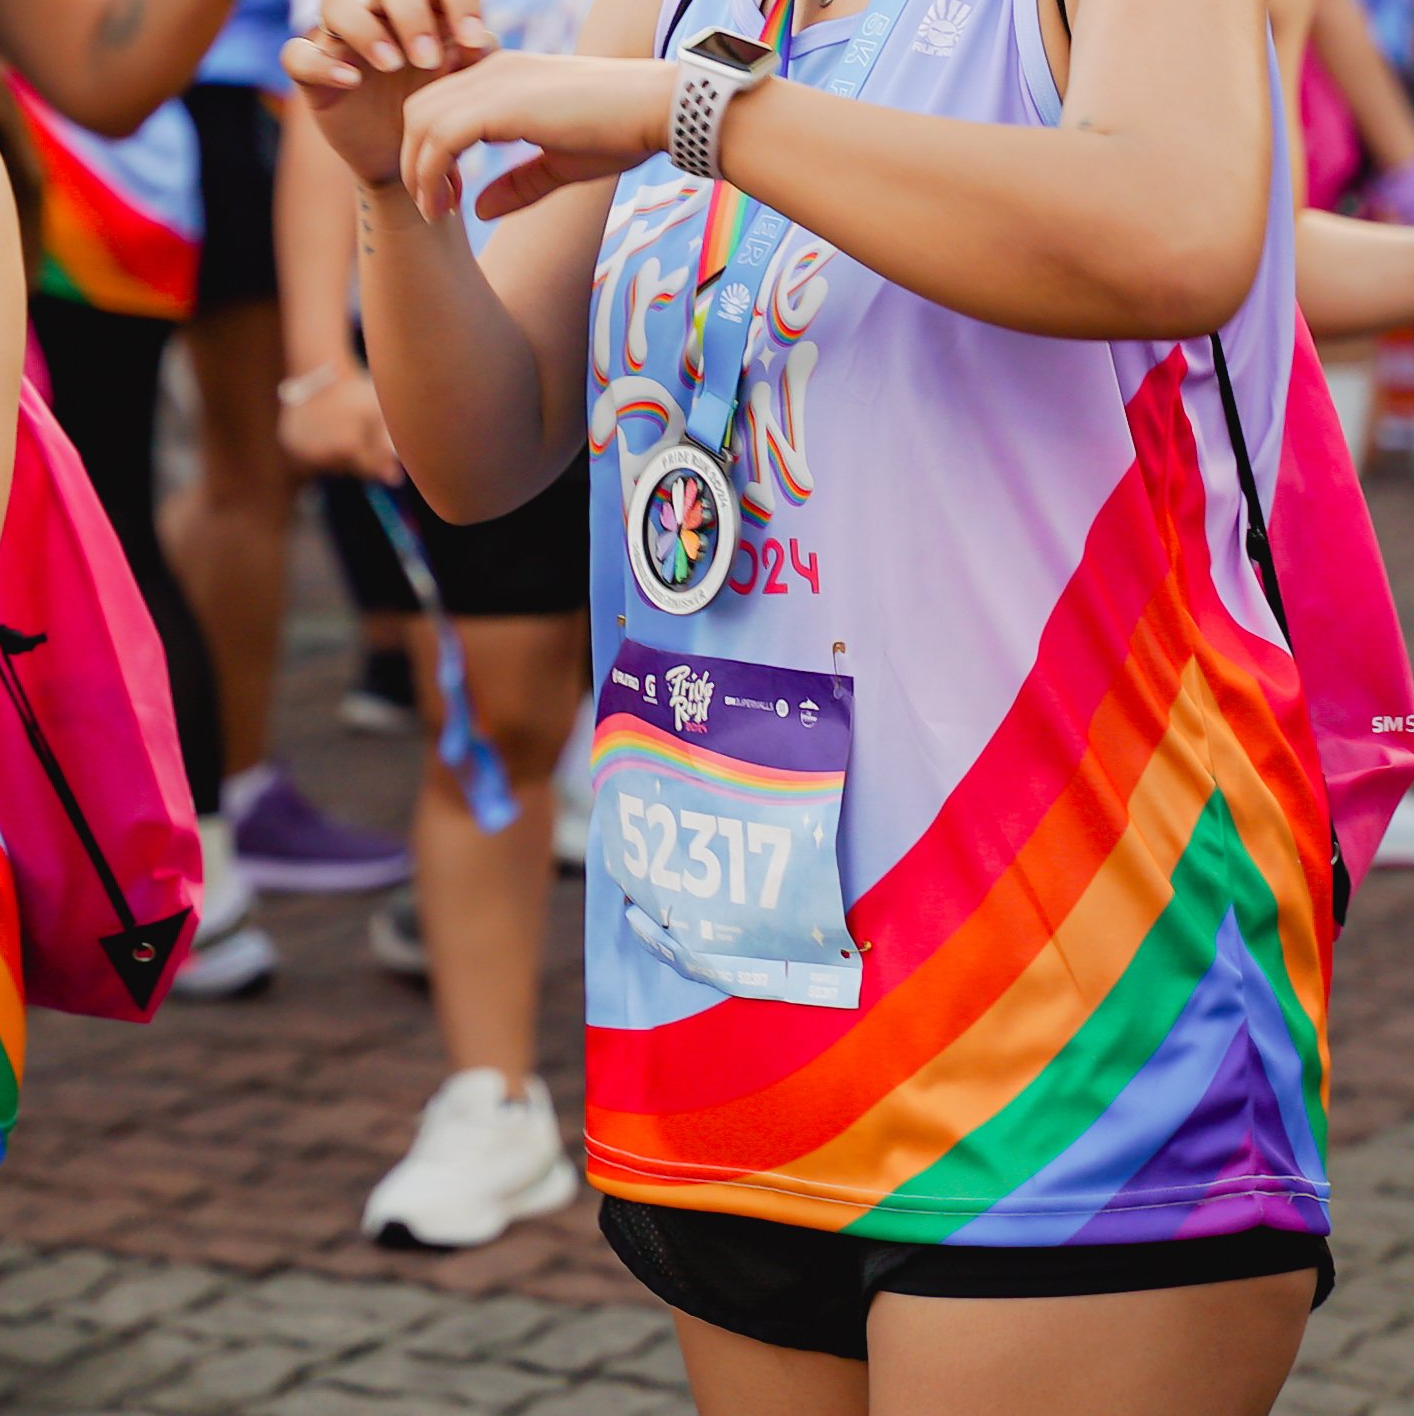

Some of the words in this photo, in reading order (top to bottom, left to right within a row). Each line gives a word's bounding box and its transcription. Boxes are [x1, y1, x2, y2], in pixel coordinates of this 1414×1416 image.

[727, 537, 820, 596] 024
[1372, 715, 1403, 733] SM
[619, 792, 791, 910] 52317
